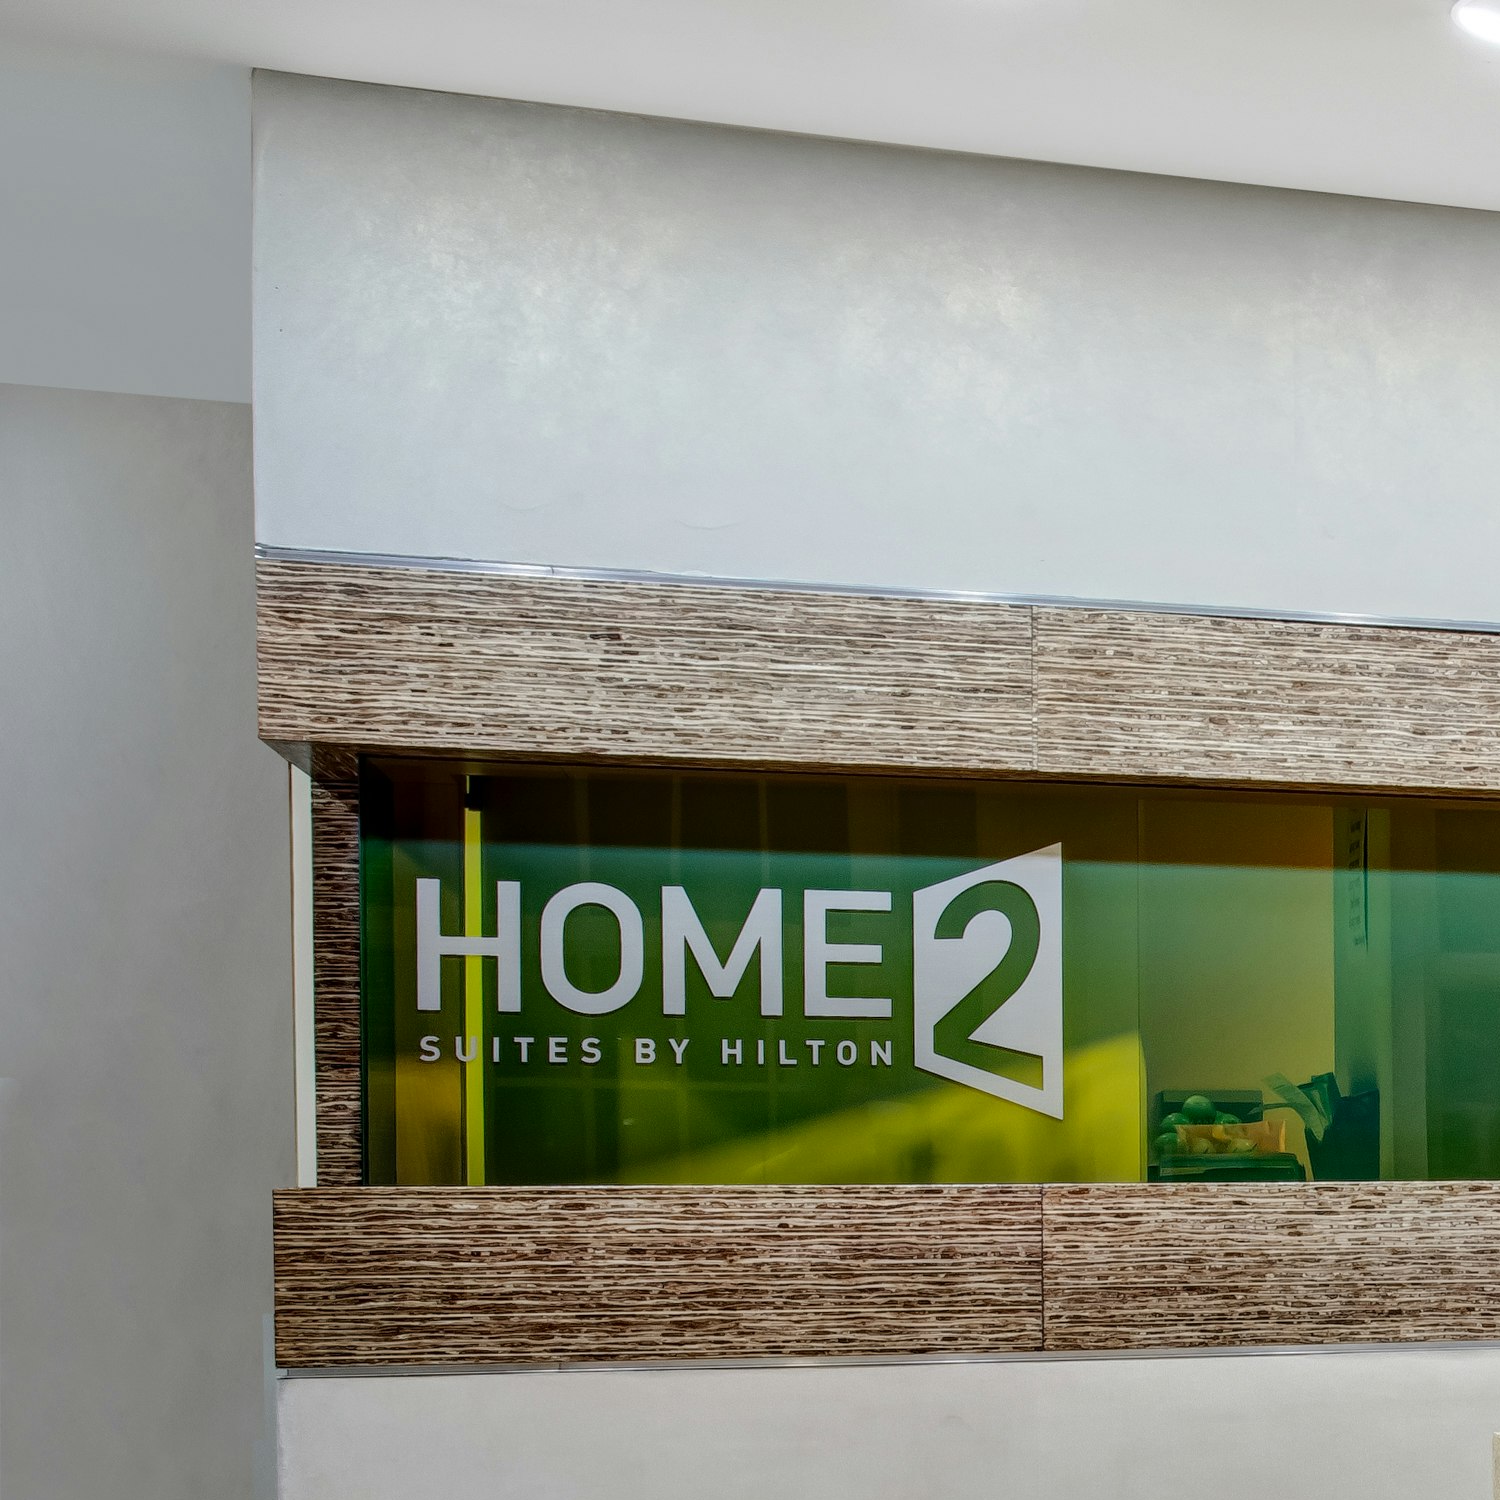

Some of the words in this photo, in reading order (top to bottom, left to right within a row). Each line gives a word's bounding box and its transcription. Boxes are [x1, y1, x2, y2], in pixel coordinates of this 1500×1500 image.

[418, 1035, 602, 1065] SUITES
[635, 1038, 690, 1065] BY
[721, 1039, 894, 1067] HILTON
